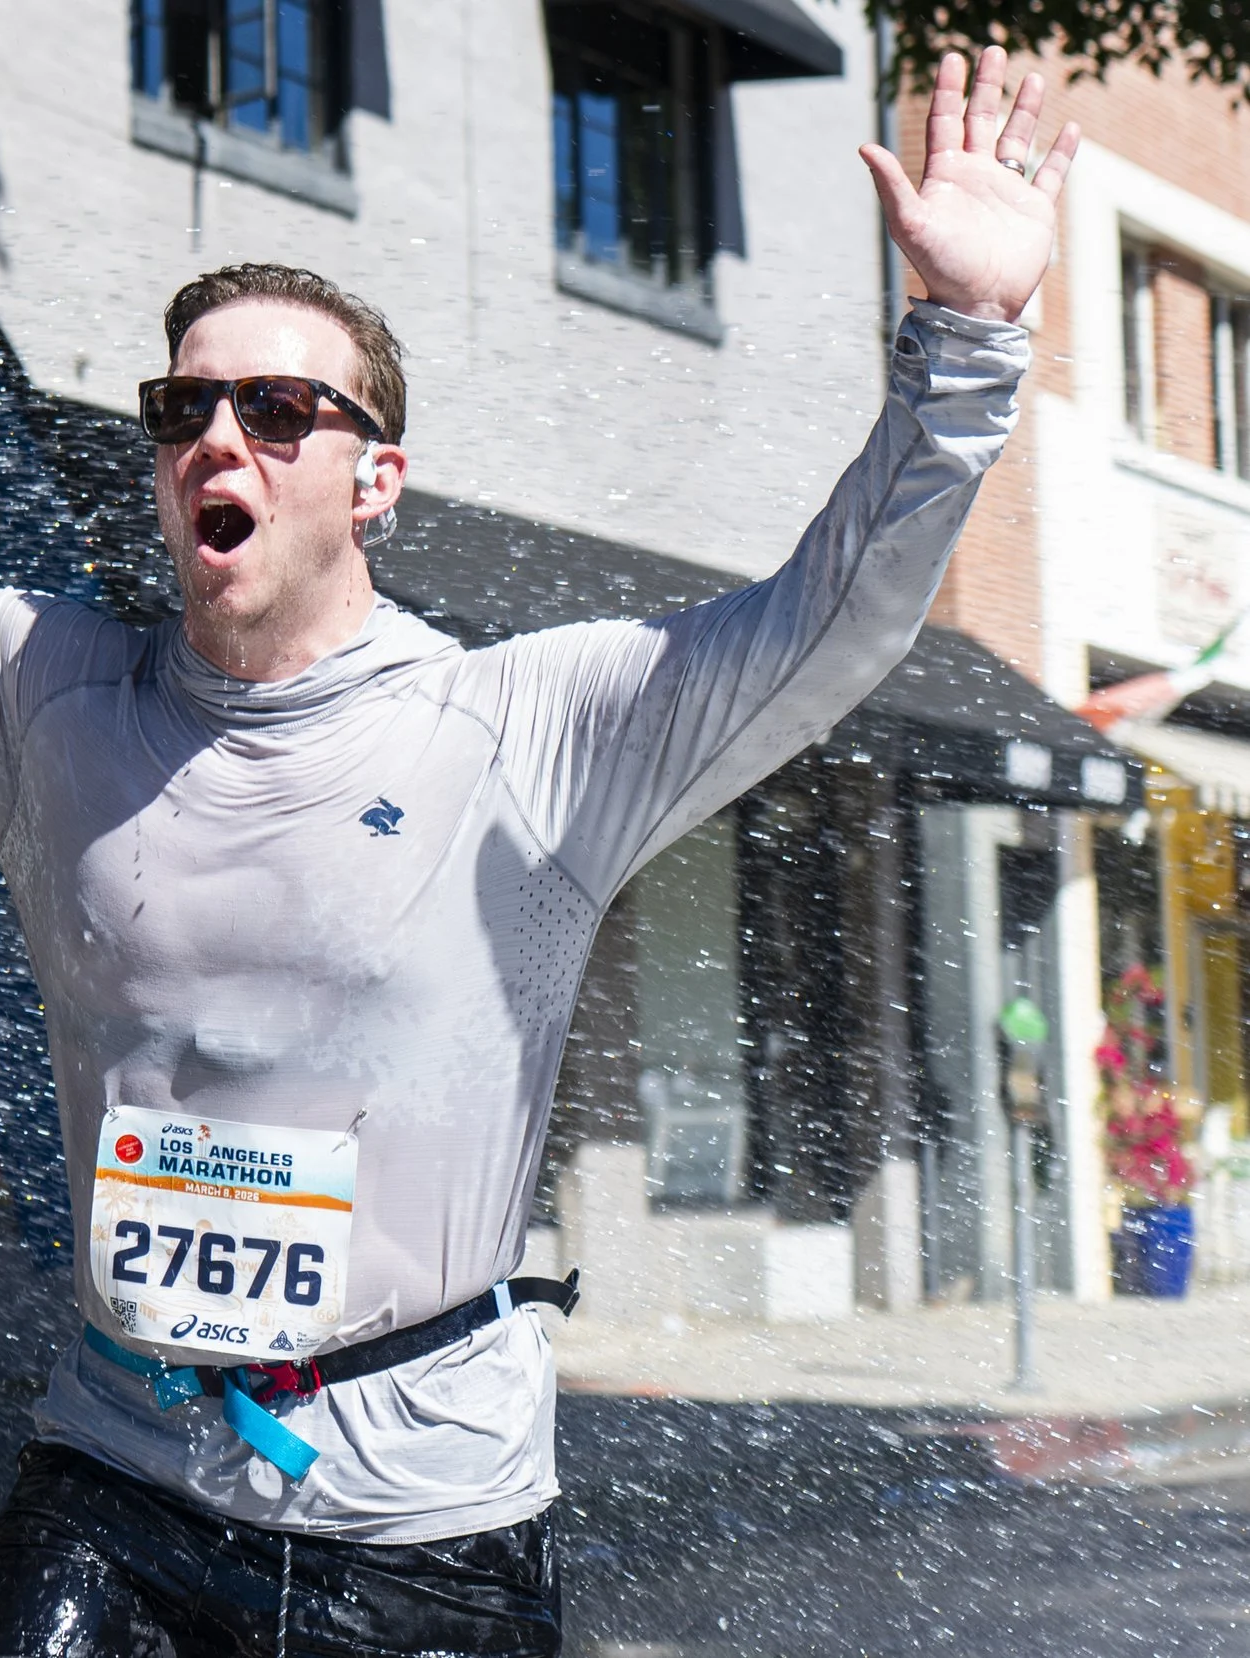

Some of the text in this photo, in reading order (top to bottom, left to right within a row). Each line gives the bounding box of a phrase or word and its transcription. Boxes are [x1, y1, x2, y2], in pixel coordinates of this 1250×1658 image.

[172, 1125, 193, 1136] asics
[160, 1138, 193, 1154] LOS
[209, 1145, 293, 1167] ANGELES
[159, 1155, 291, 1187] MARATHON
[185, 1182, 221, 1197] MARCH
[234, 1190, 260, 1202] 2026
[112, 1220, 324, 1307] 27676
[317, 1309, 335, 1321] 66
[196, 1322, 250, 1344] asics
